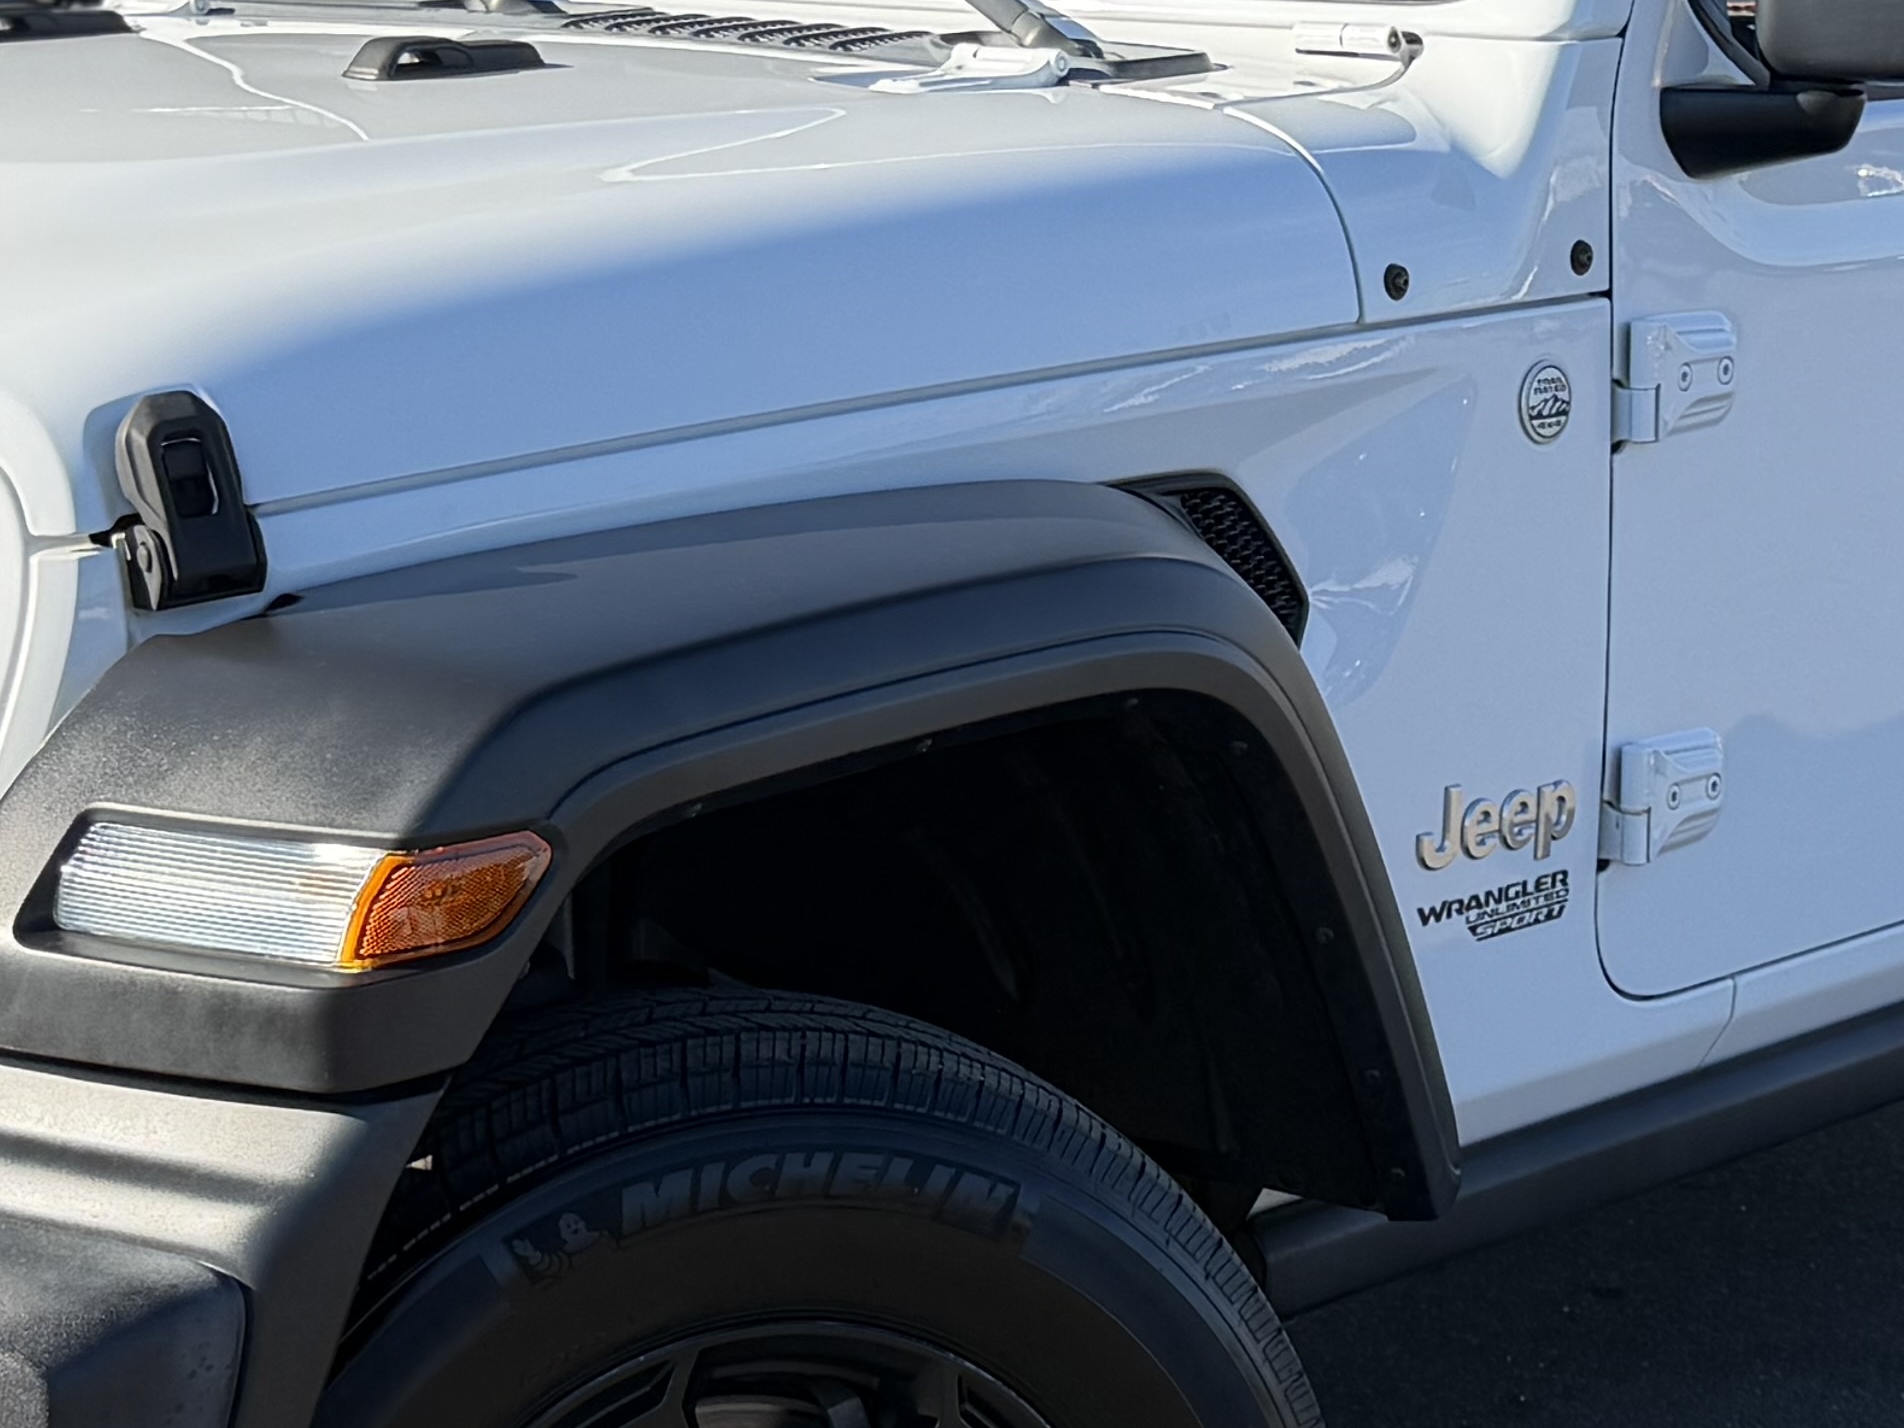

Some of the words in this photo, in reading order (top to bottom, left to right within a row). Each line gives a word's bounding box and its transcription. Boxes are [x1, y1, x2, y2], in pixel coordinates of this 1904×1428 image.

[1415, 779, 1577, 870] Jeep
[1417, 869, 1569, 927] WRANGLER
[1465, 888, 1570, 924] UNLIMITED
[618, 1150, 1020, 1241] MICHELIN
